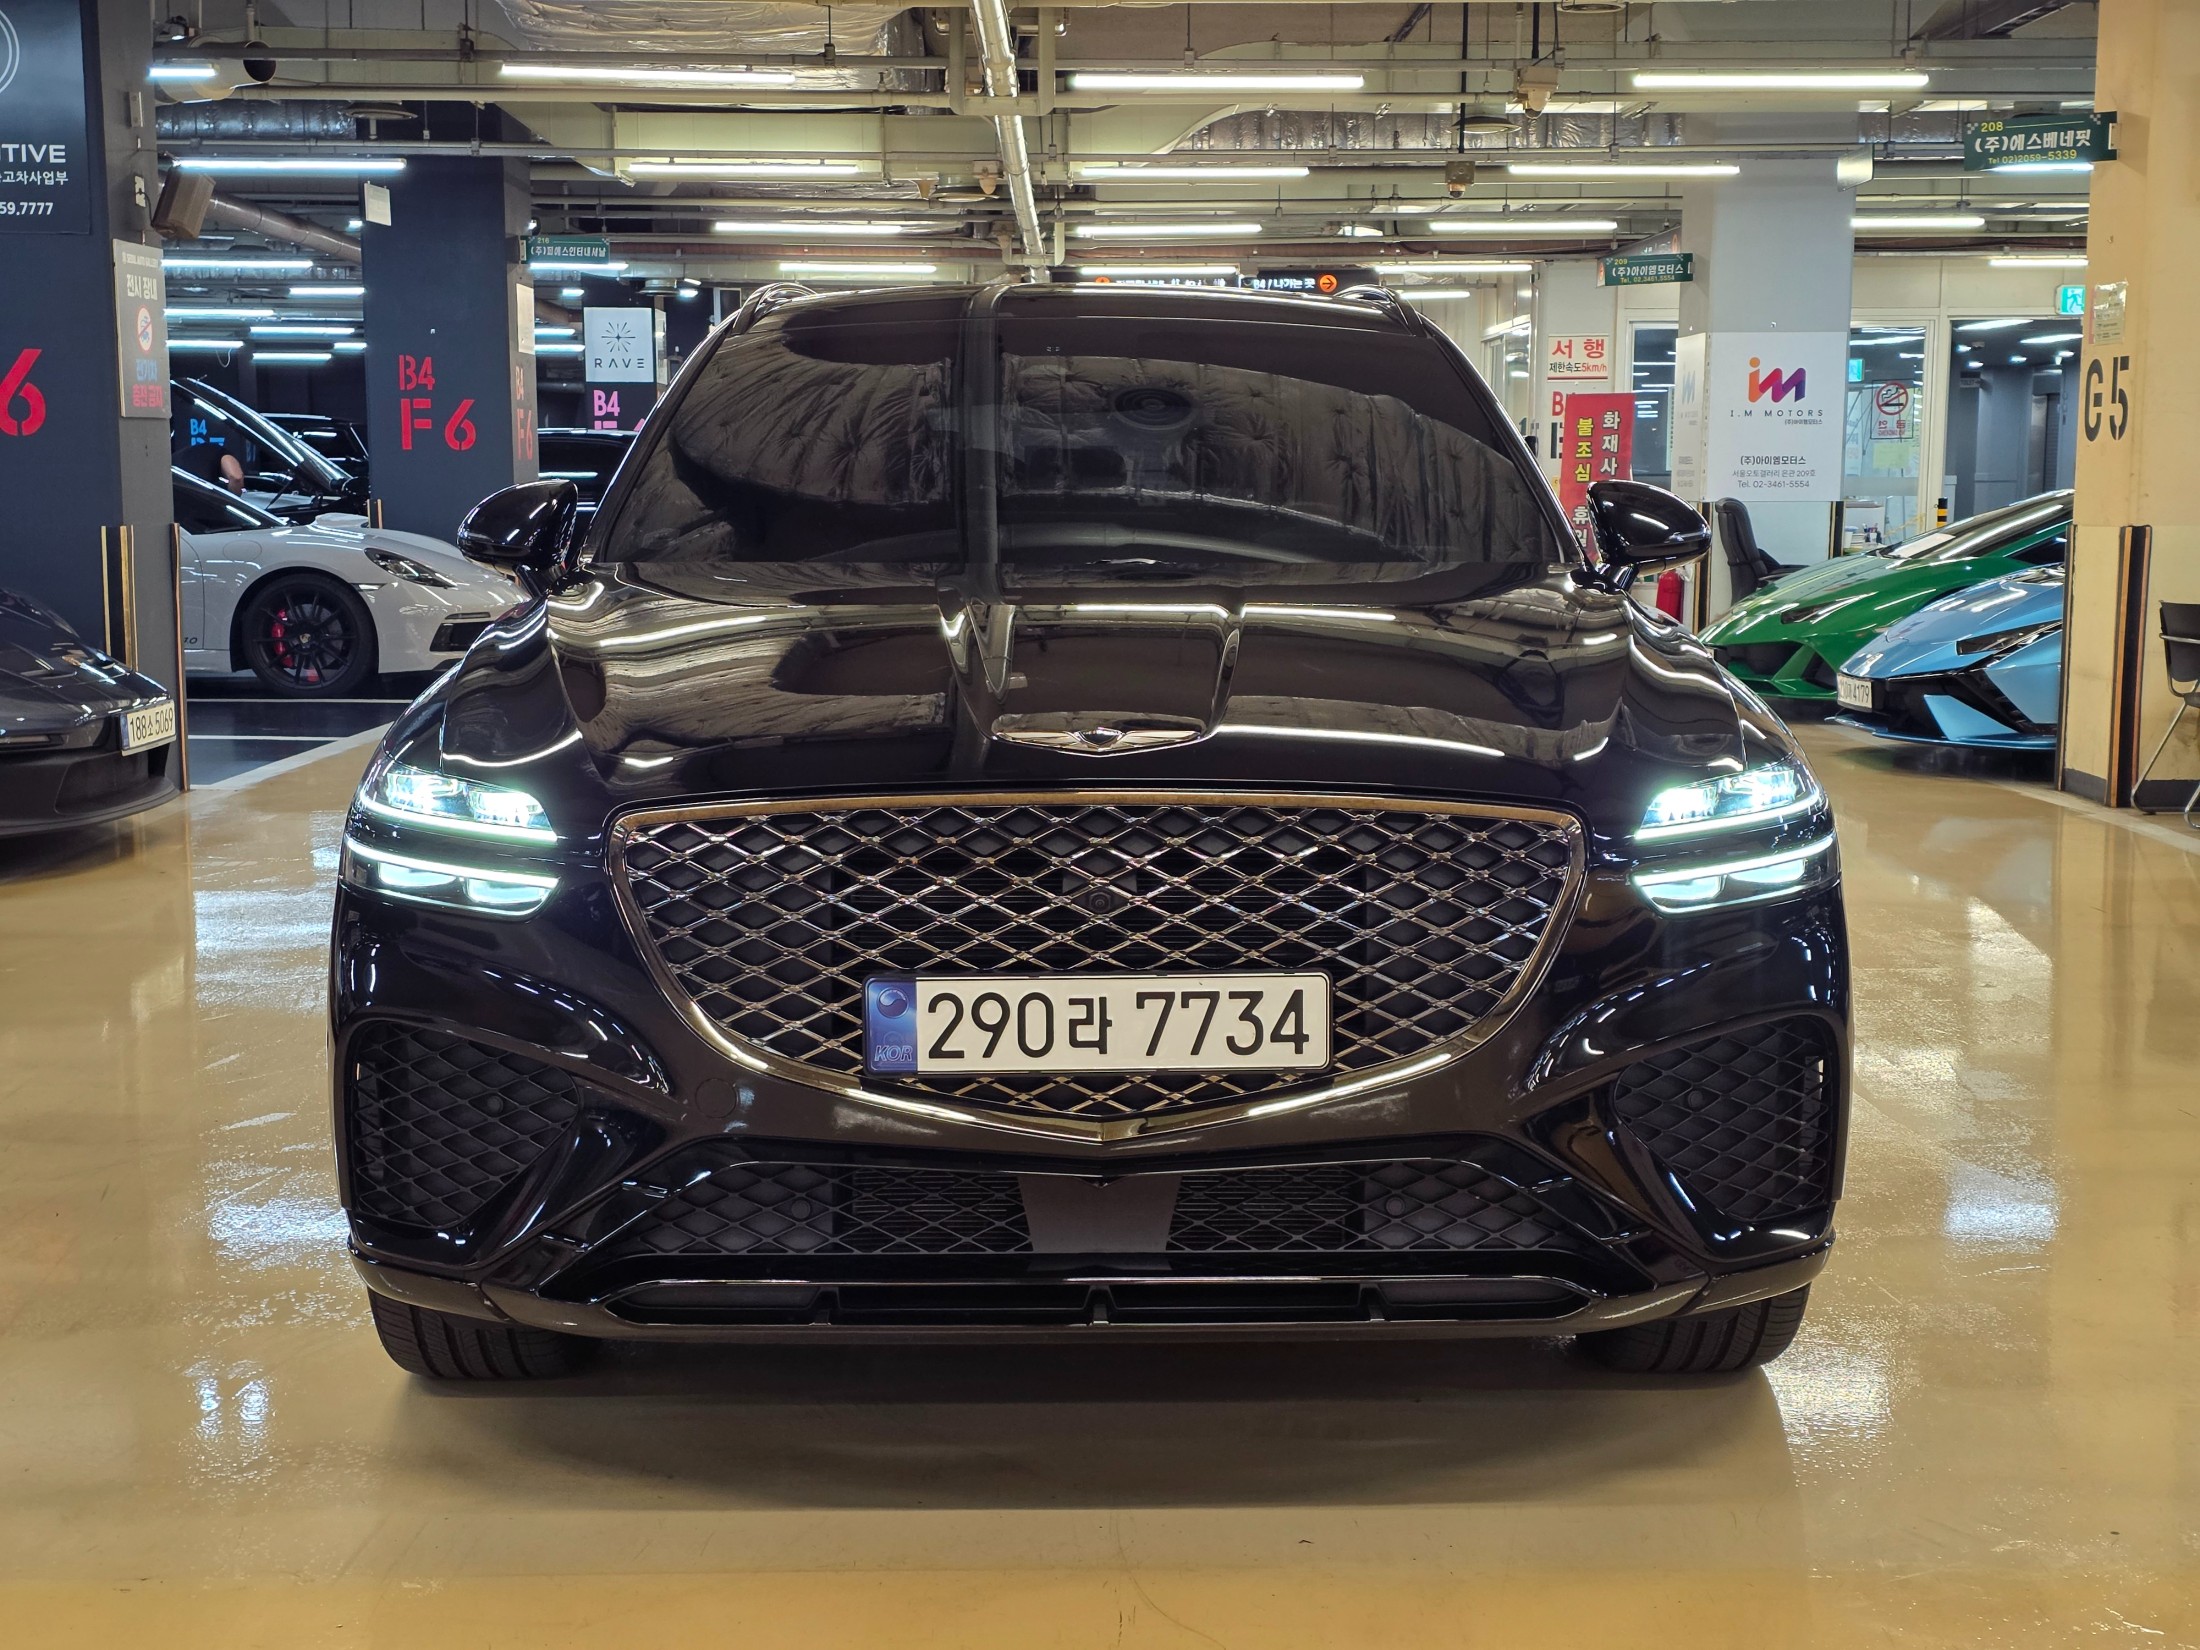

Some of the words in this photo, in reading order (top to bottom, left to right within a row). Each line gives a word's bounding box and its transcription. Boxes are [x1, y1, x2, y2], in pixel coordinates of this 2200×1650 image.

[1980, 122, 2004, 132] 208
[1974, 129, 2091, 153] (주)에스베네핏
[0, 143, 66, 163] TIVE
[1988, 157, 2000, 165] Tel
[2001, 149, 2078, 164] 02)2059-5339
[0, 201, 54, 216] 59.7777
[1273, 278, 1303, 289] 나가는
[399, 354, 436, 391] B4
[594, 358, 645, 369] RAVE
[0, 348, 47, 436] 6
[593, 389, 621, 417] B4
[1730, 409, 1753, 418] I.M
[1764, 409, 1824, 418] MOTORS
[190, 418, 207, 436] B4
[1574, 416, 1594, 482] 불조심
[1740, 455, 1807, 466] (주)아이엠모터스
[1732, 469, 1780, 479] 서울오토갤러리
[1796, 469, 1817, 478] 209호
[1752, 480, 1810, 489] 02-3461-5554
[130, 714, 154, 742] 188소
[154, 706, 174, 736] 5069
[927, 991, 1113, 1060] 290라
[1135, 988, 1310, 1058] 7734
[874, 1043, 913, 1062] KOR
